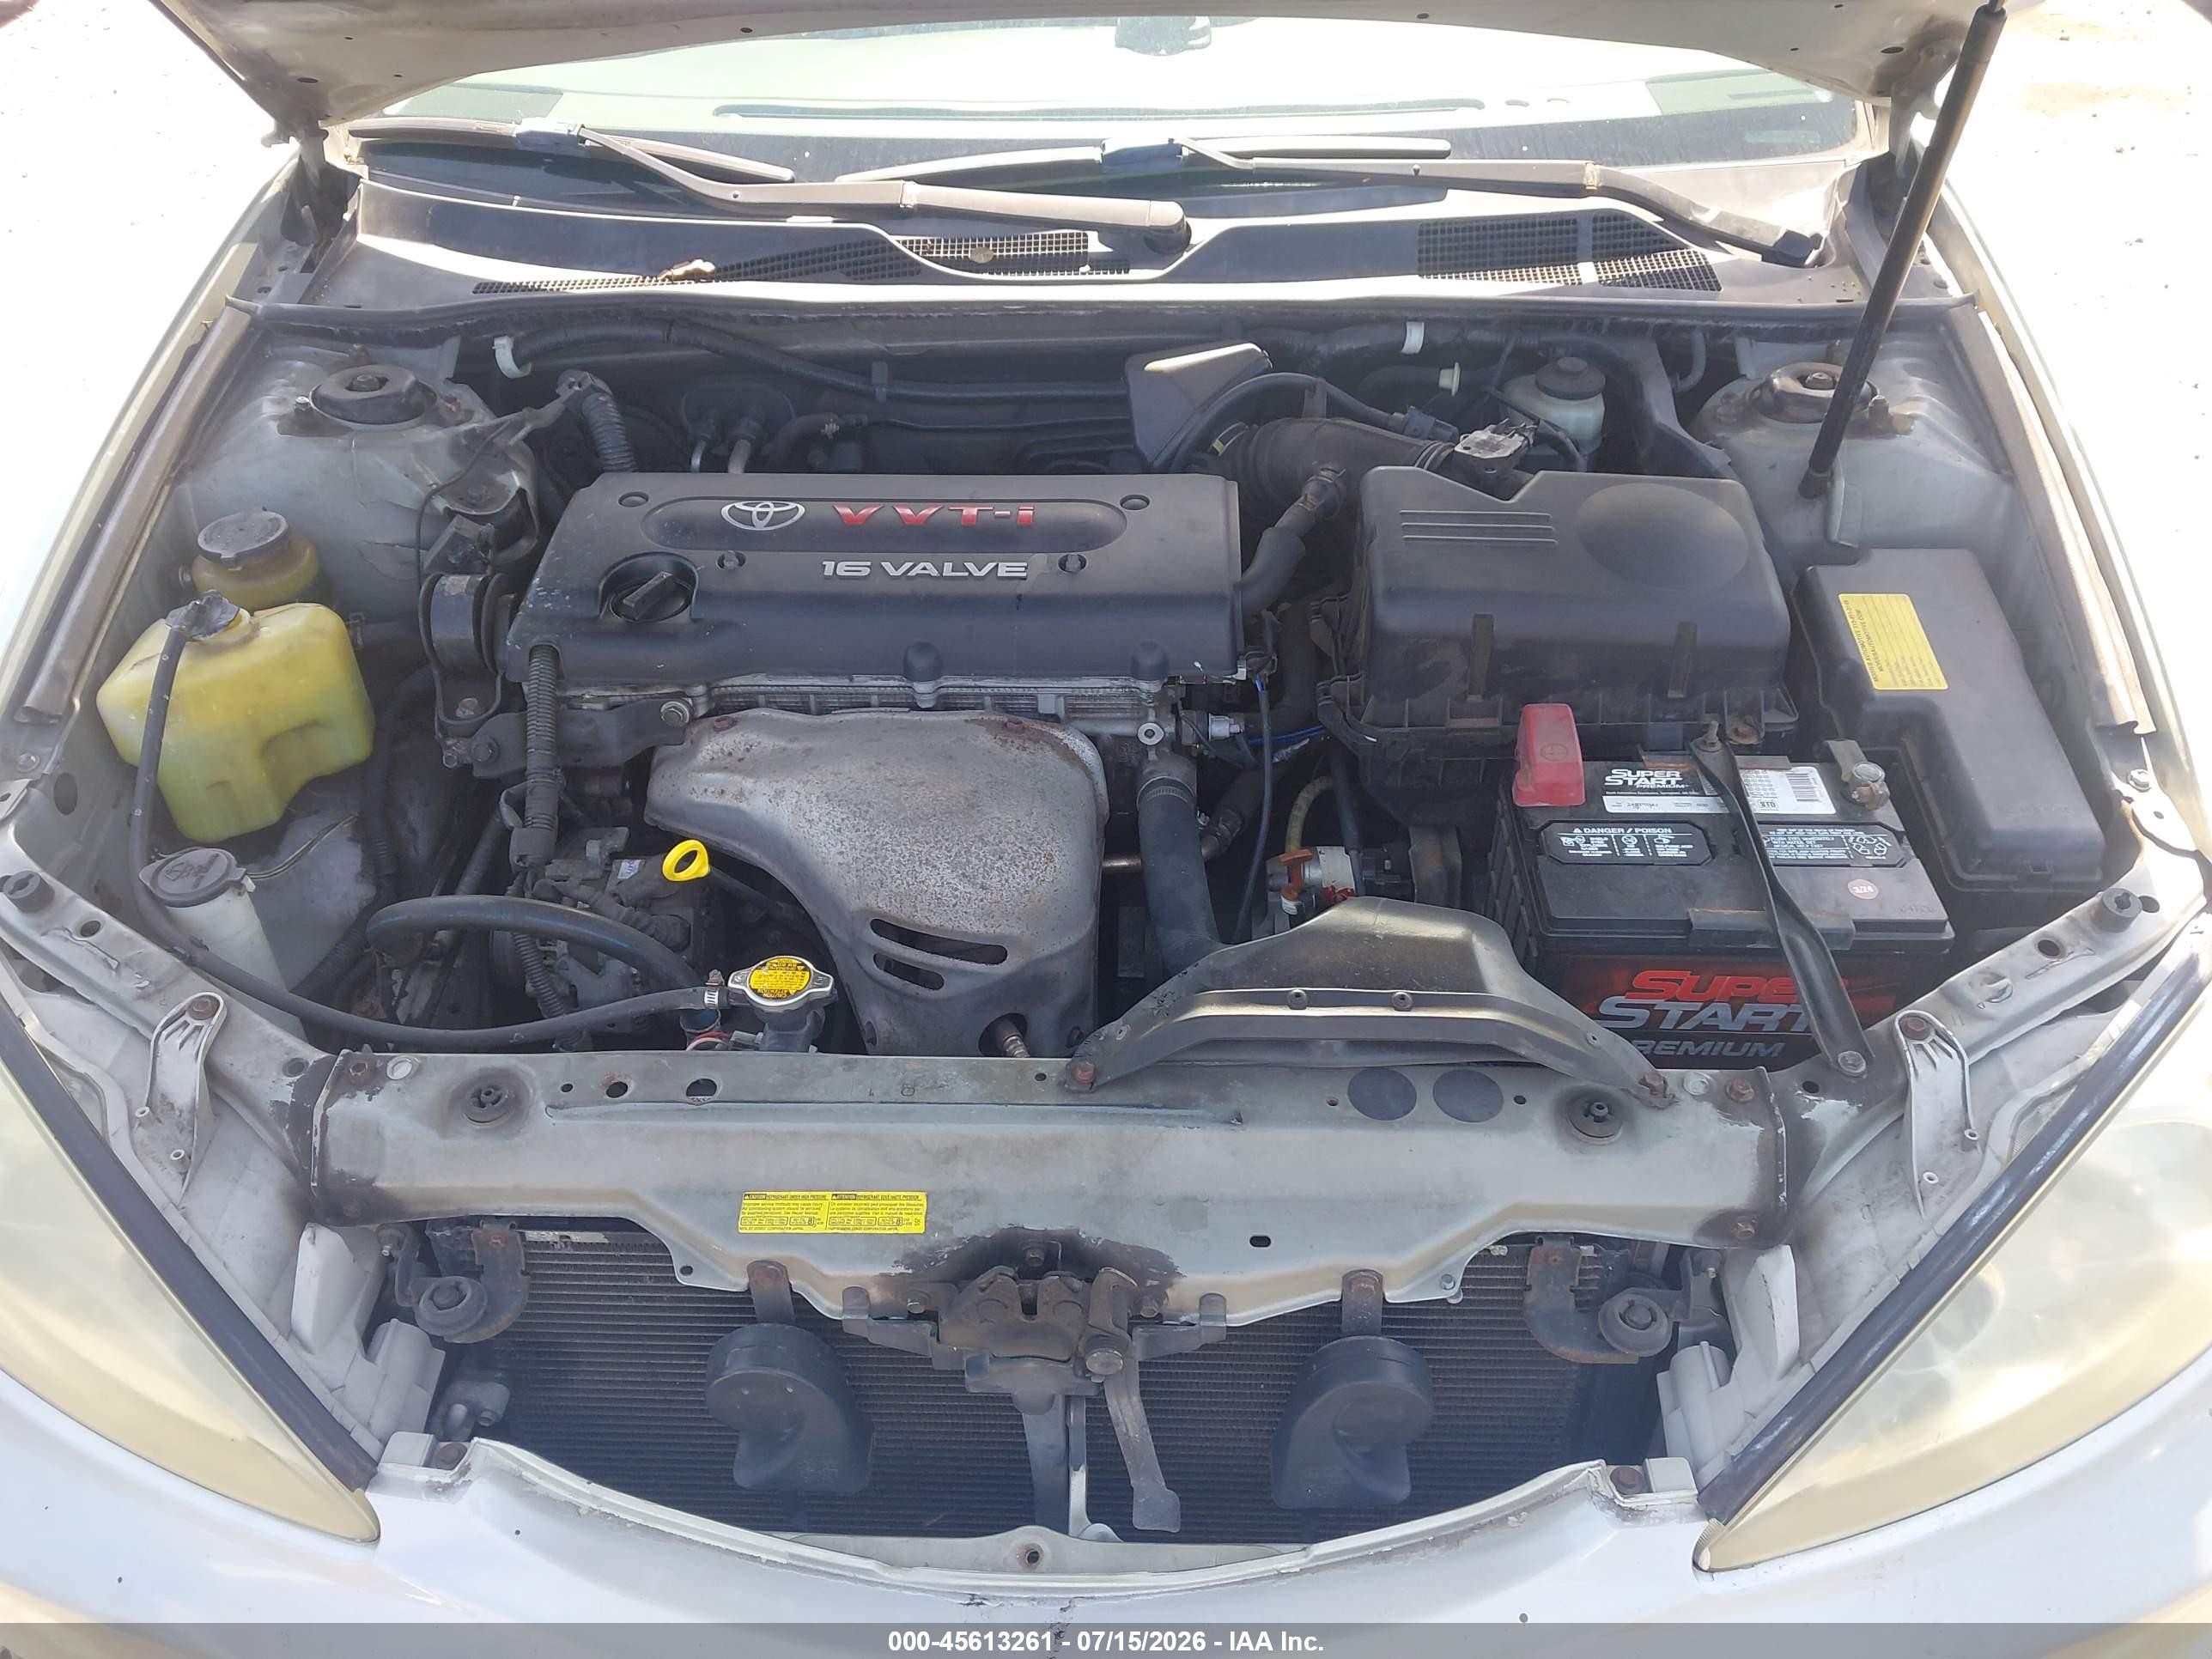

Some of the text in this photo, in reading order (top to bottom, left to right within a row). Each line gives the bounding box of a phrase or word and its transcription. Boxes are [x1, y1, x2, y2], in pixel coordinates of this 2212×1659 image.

[833, 505, 1035, 526] VVT-i
[822, 561, 1029, 578] 16 VALVE
[1604, 775, 1683, 786] START
[1611, 769, 1681, 778] SUPER
[1852, 885, 1875, 894] 3/24
[1625, 969, 1802, 1004] SUPE
[1631, 1039, 1786, 1057] REMIUM
